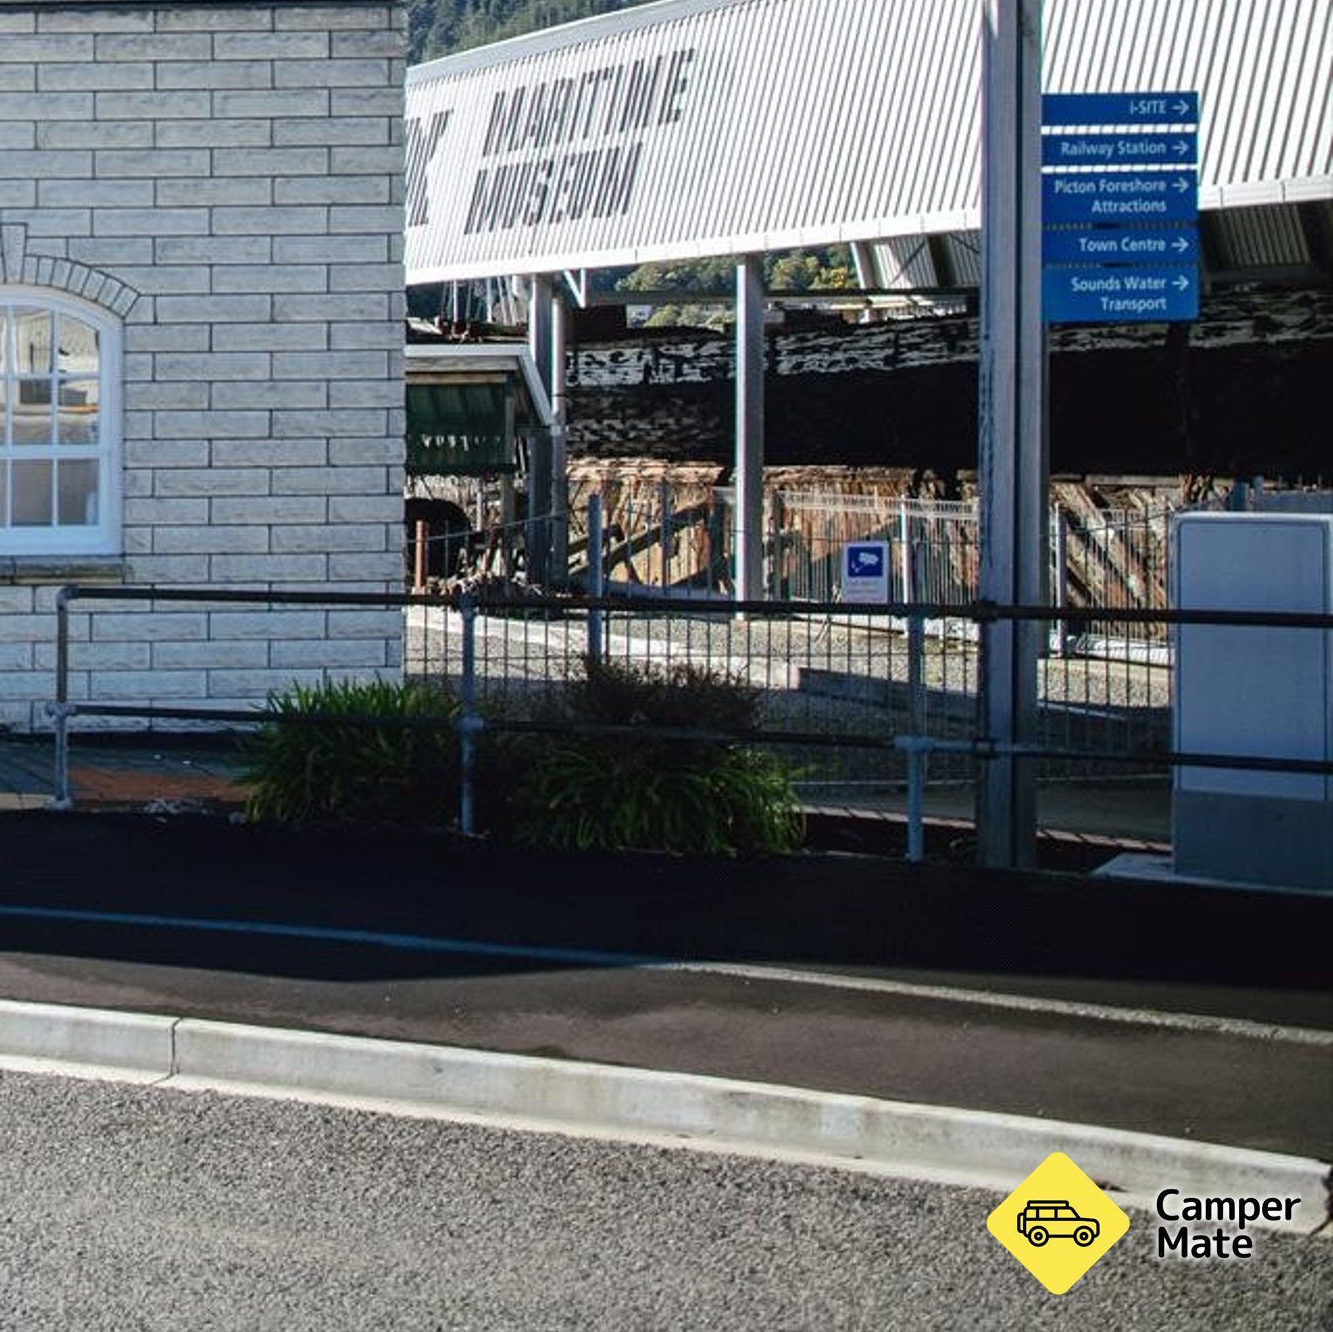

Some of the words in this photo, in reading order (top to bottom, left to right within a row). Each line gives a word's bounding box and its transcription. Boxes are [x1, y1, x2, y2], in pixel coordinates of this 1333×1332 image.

[483, 48, 694, 157] MARITIME
[1061, 140, 1113, 158] Railway
[1117, 140, 1166, 155] Station
[1055, 179, 1096, 194] Picton
[1099, 178, 1166, 193] Foreshore
[1091, 198, 1166, 213] Attractions
[1079, 238, 1118, 252] Town
[1121, 237, 1166, 252] Centre
[1071, 276, 1121, 292] Sounds
[1124, 276, 1166, 290] Water
[1101, 296, 1166, 313] Transport
